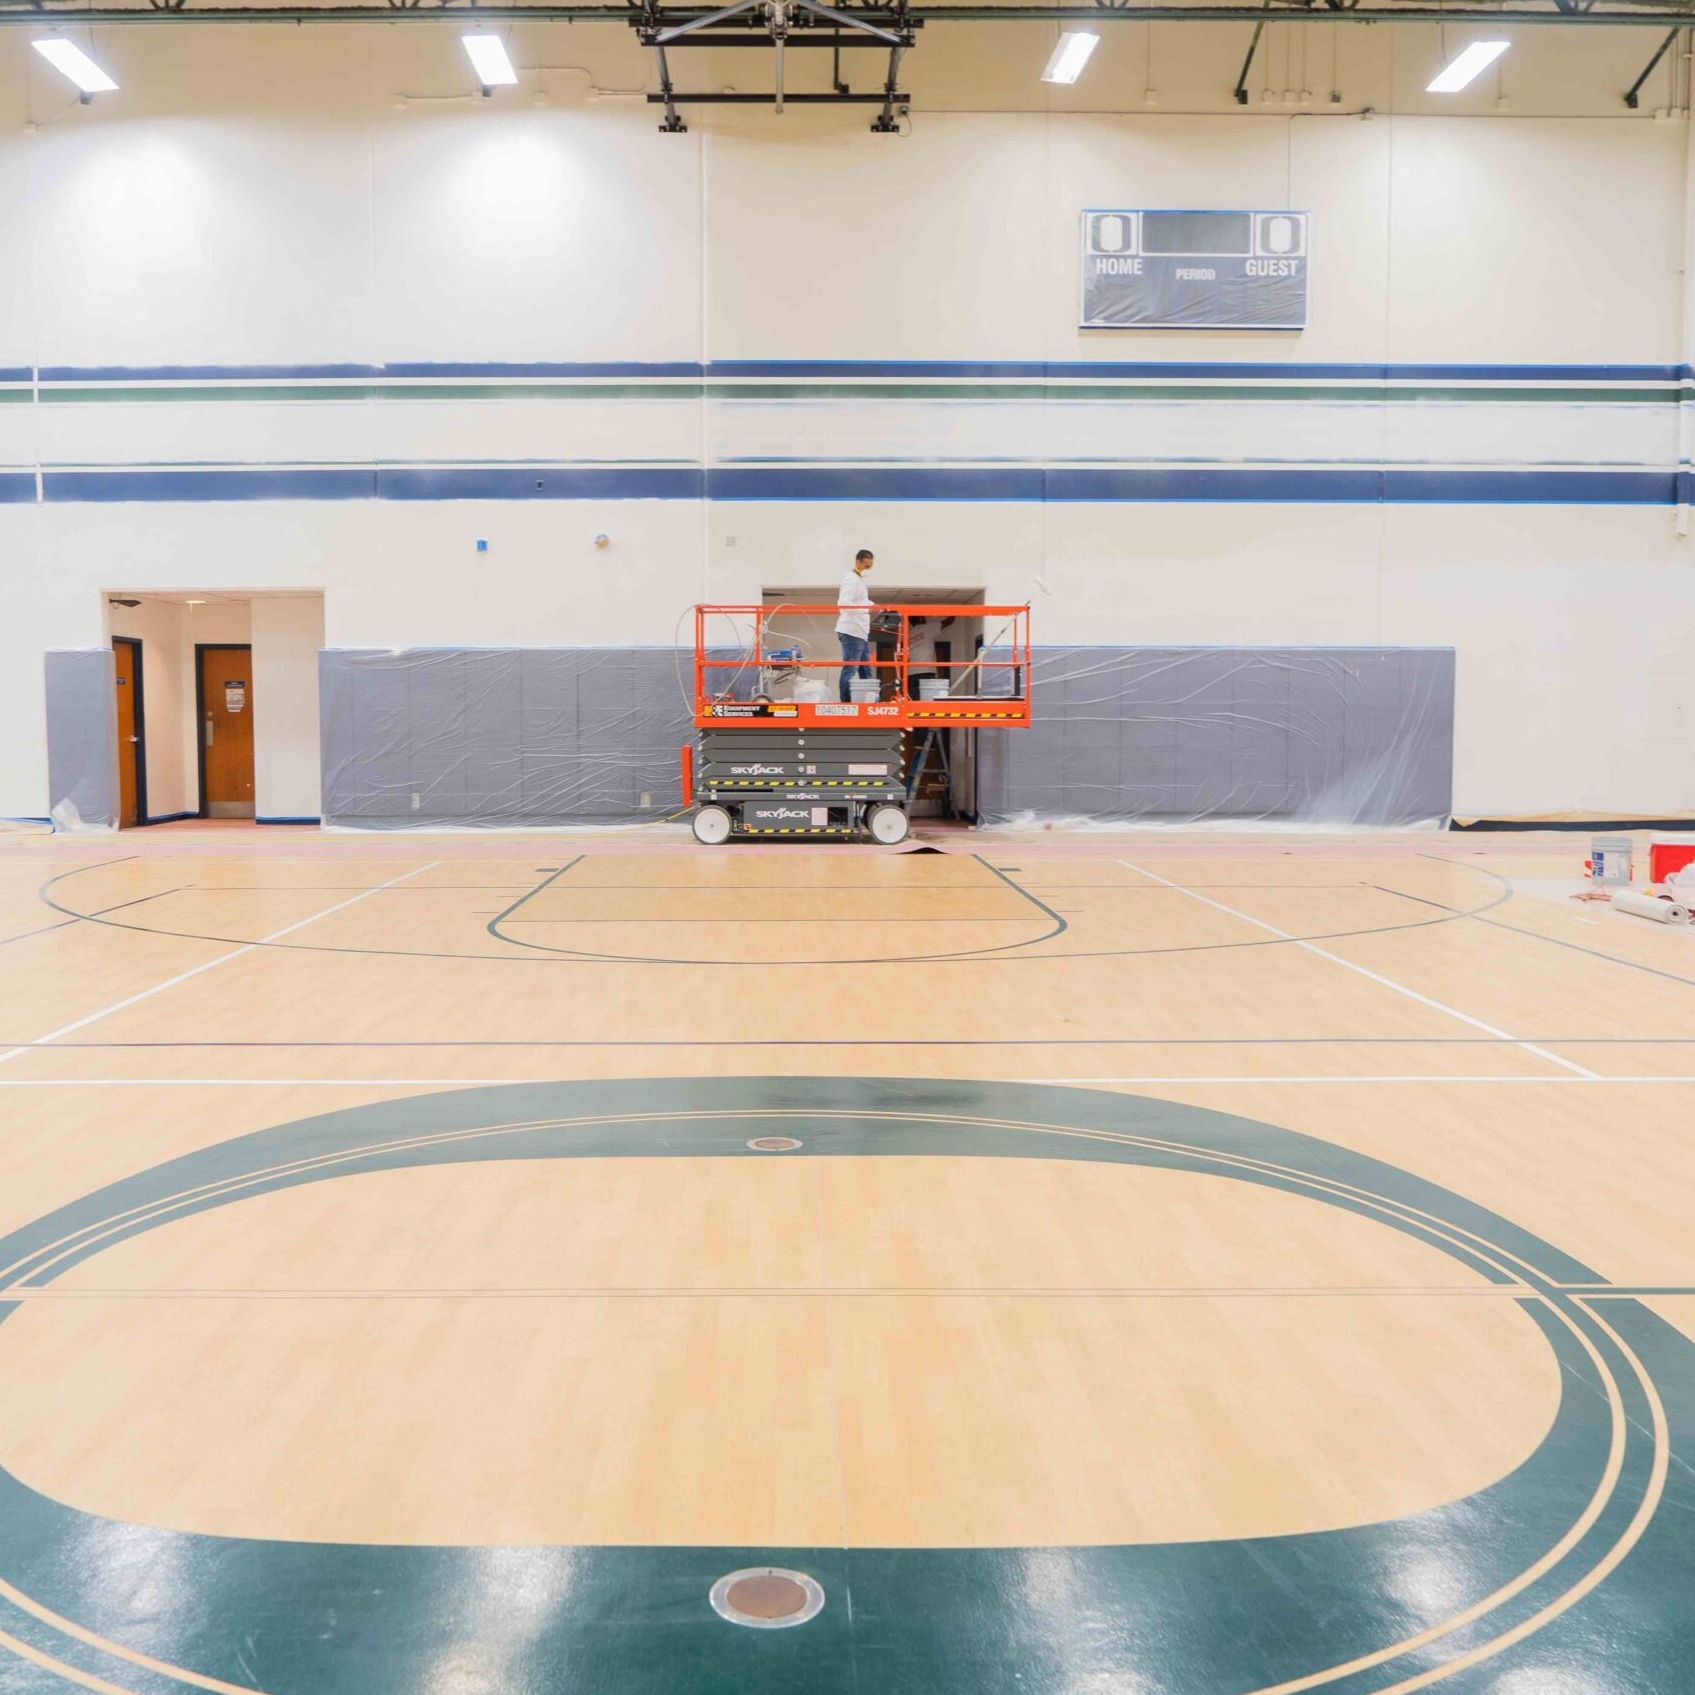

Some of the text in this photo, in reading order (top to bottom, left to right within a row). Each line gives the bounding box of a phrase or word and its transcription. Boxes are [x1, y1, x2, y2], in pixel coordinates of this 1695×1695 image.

[1095, 258, 1143, 275] HOME
[1246, 259, 1299, 276] GUEST
[1175, 268, 1216, 280] PERIOD
[867, 706, 899, 716] SJ4732
[731, 763, 785, 776] SKYJACK
[756, 807, 810, 819] SKYJACK
